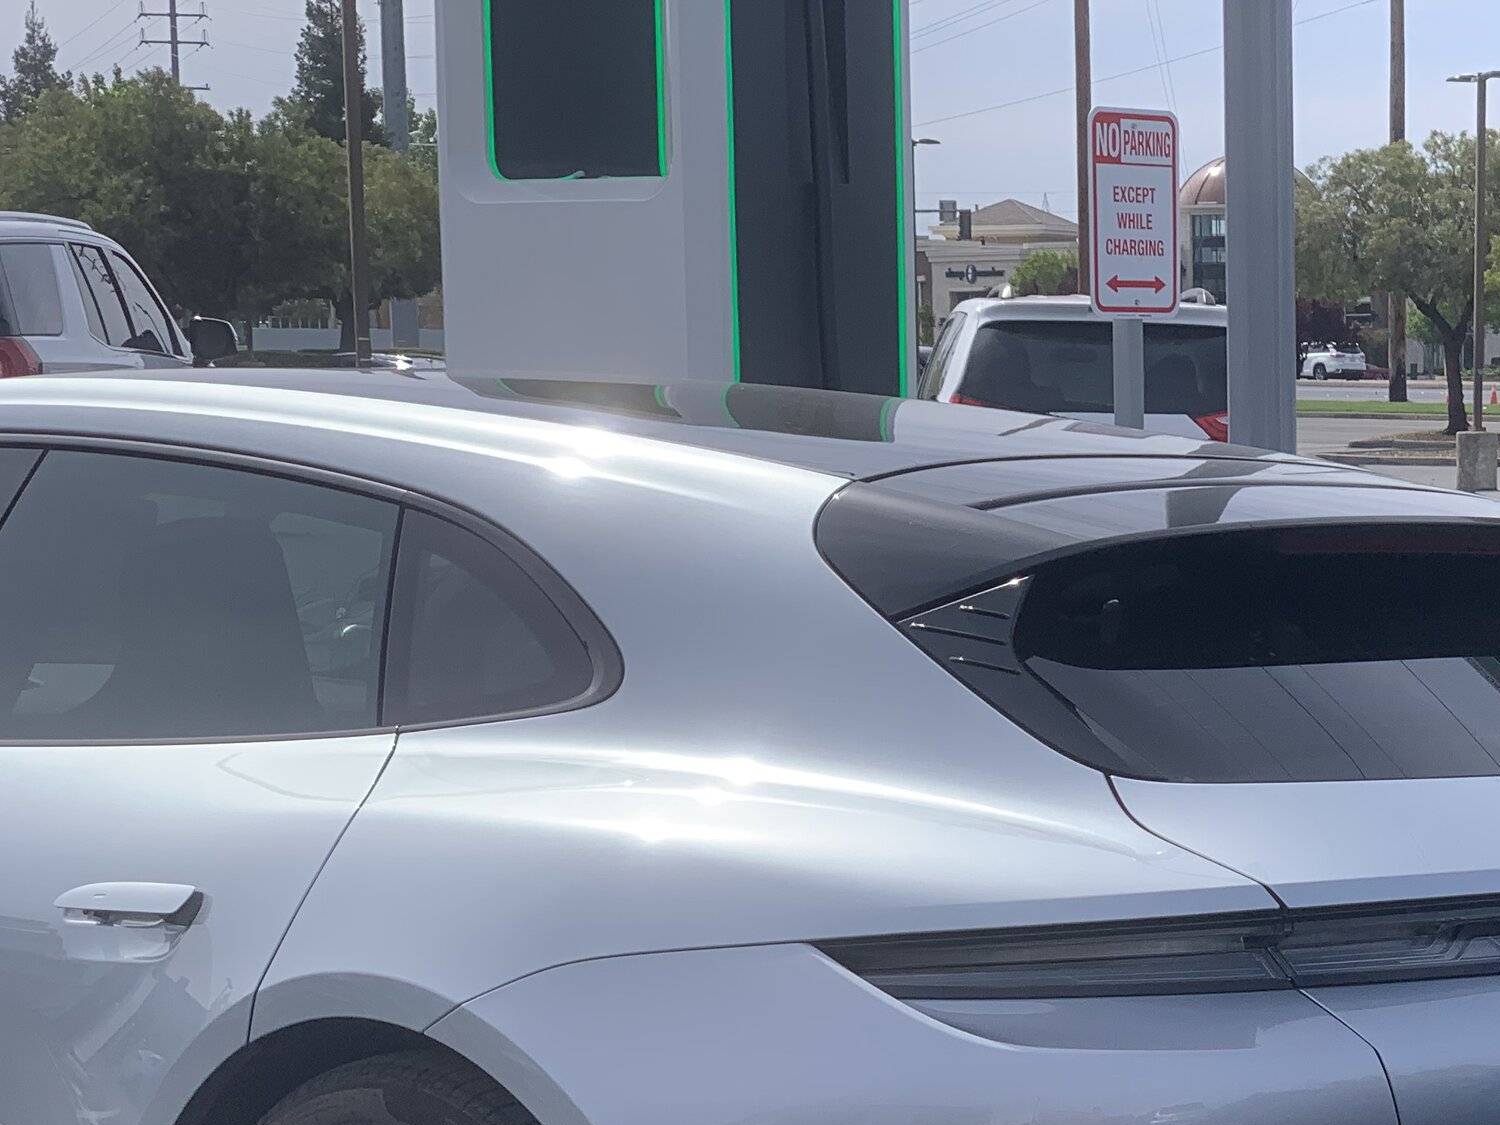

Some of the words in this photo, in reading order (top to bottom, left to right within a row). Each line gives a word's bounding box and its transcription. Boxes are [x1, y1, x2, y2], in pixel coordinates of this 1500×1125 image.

[1096, 122, 1120, 158] NO
[1123, 129, 1171, 158] PARKING
[1113, 185, 1156, 205] EXCEPT
[1116, 212, 1153, 231] WHILE
[1105, 238, 1165, 257] CHARGING
